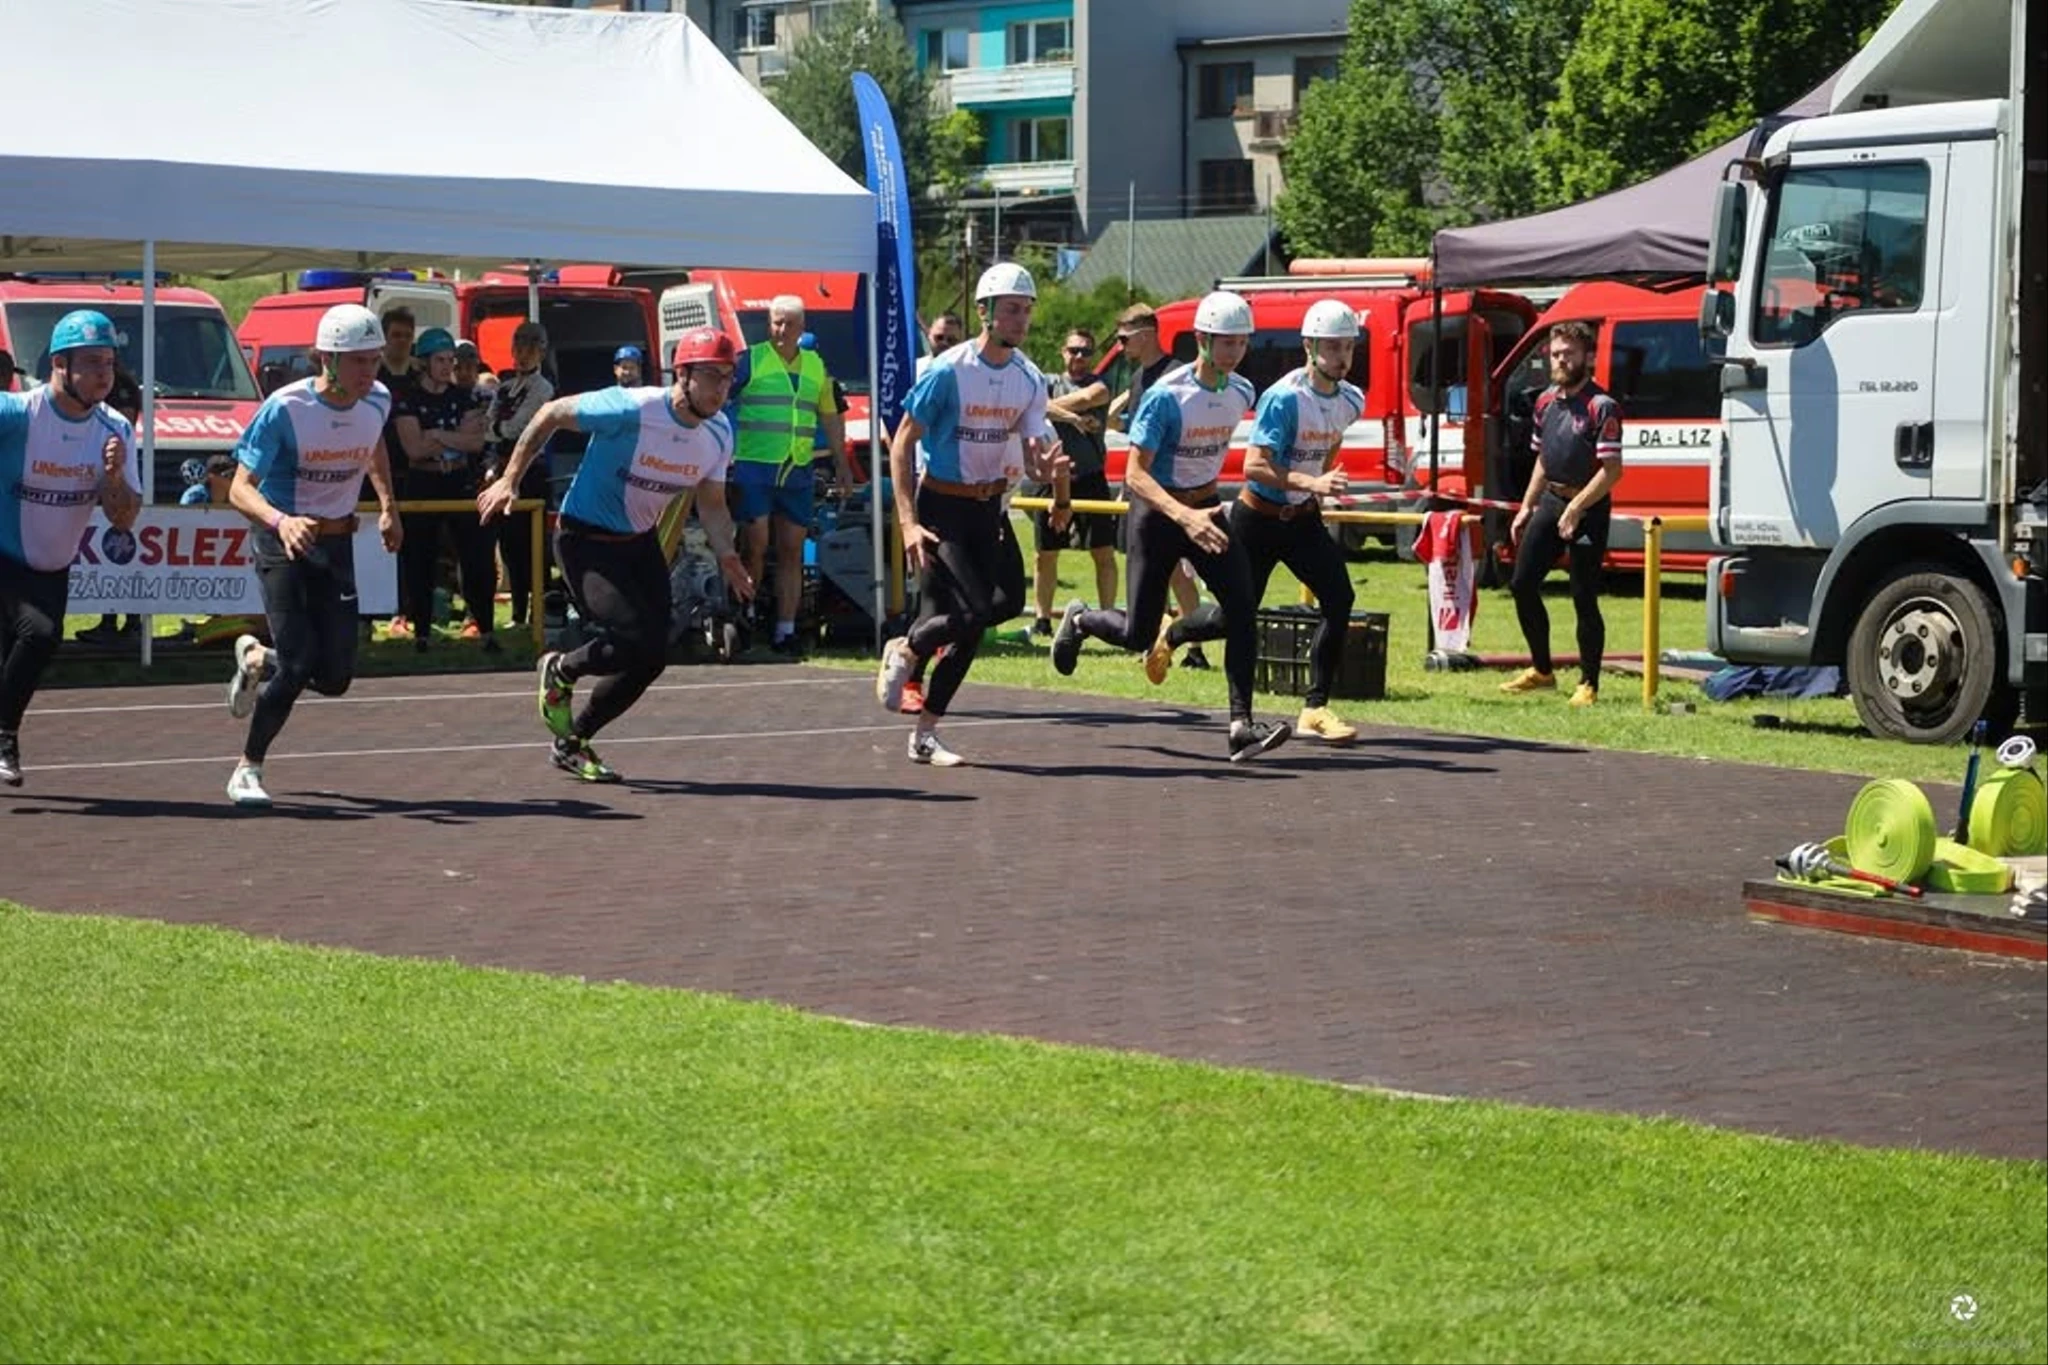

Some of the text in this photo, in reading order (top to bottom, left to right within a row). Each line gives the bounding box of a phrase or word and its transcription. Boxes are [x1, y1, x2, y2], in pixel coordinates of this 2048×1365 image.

[880, 263, 899, 418] respect.cz
[135, 414, 246, 434] ASIČI
[1639, 429, 1661, 446] DA
[1679, 428, 1711, 446] L1Z
[165, 571, 247, 599] ÚTOKU
